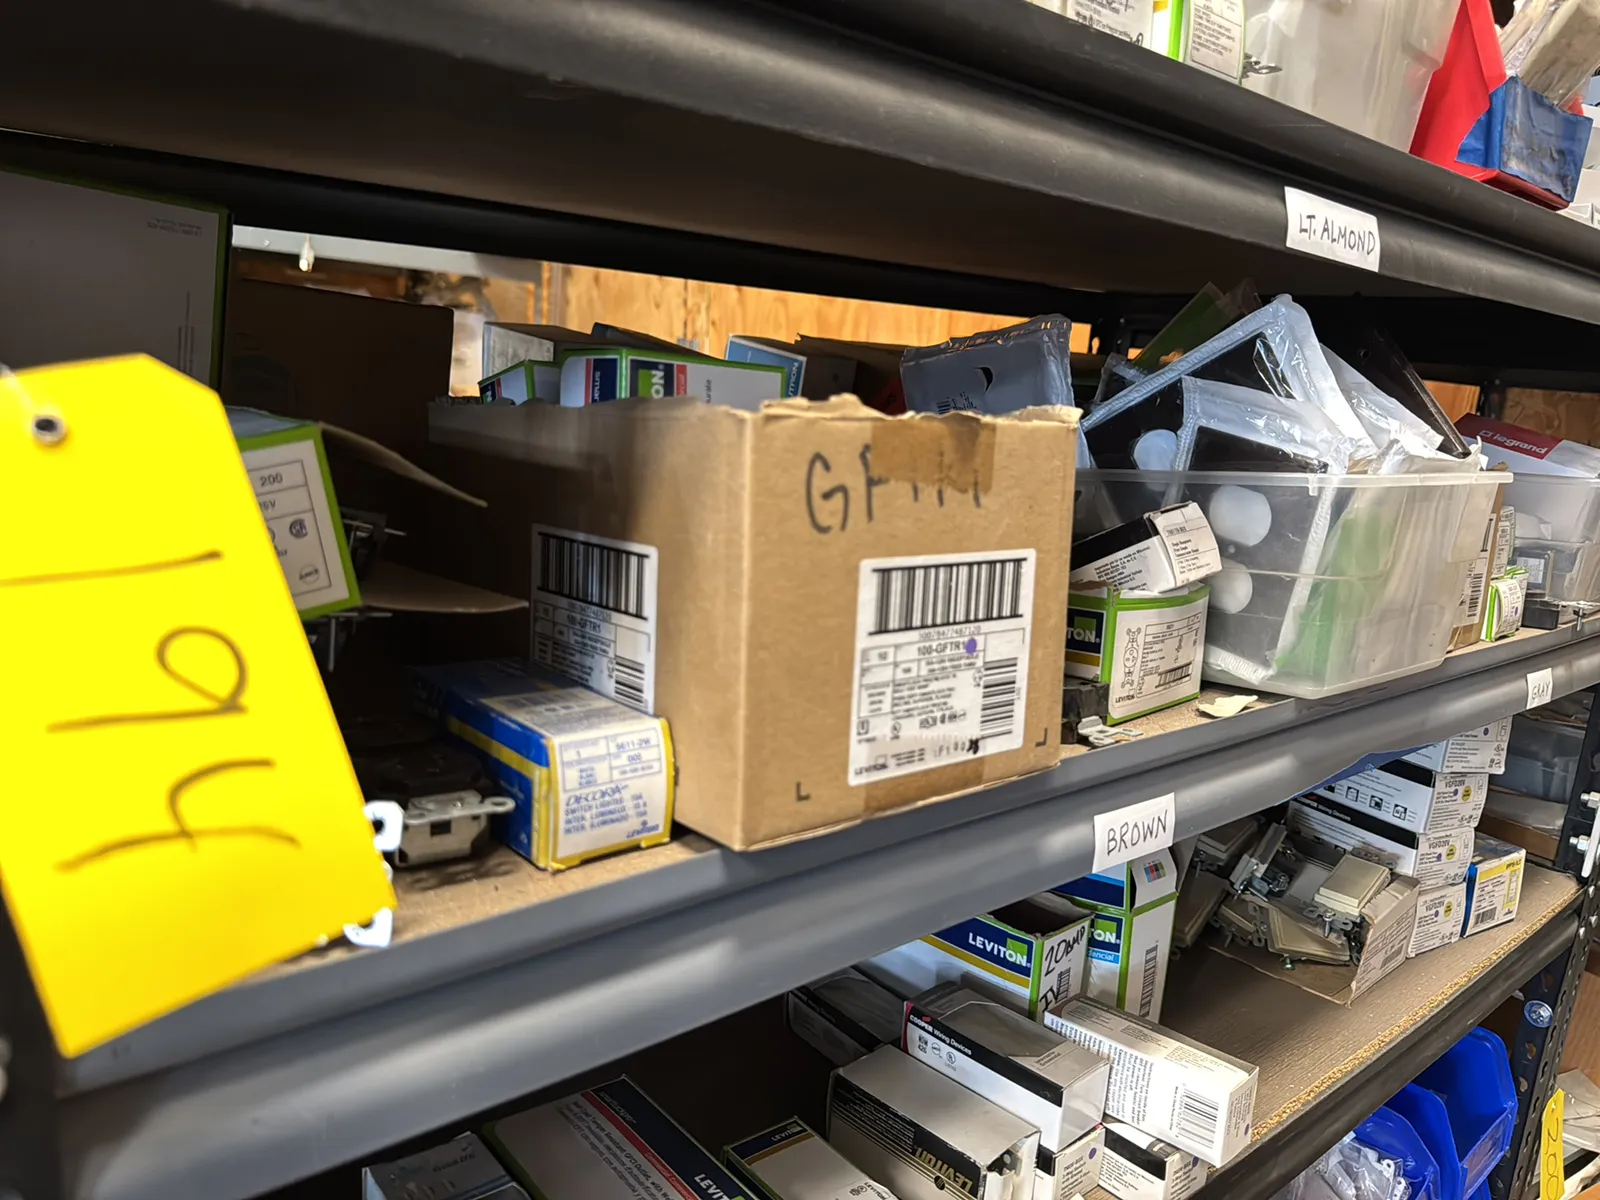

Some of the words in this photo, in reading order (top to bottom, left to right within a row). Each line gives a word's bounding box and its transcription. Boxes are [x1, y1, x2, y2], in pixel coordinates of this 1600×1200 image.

[1320, 216, 1377, 256] ALMOND
[1493, 433, 1549, 455] legrand
[260, 472, 283, 487] 200
[1107, 809, 1168, 857] BROWN
[968, 932, 1027, 967] LEVITON
[909, 1014, 934, 1033] COOPER
[933, 1028, 951, 1045] Wiring
[950, 1036, 972, 1055] Devices
